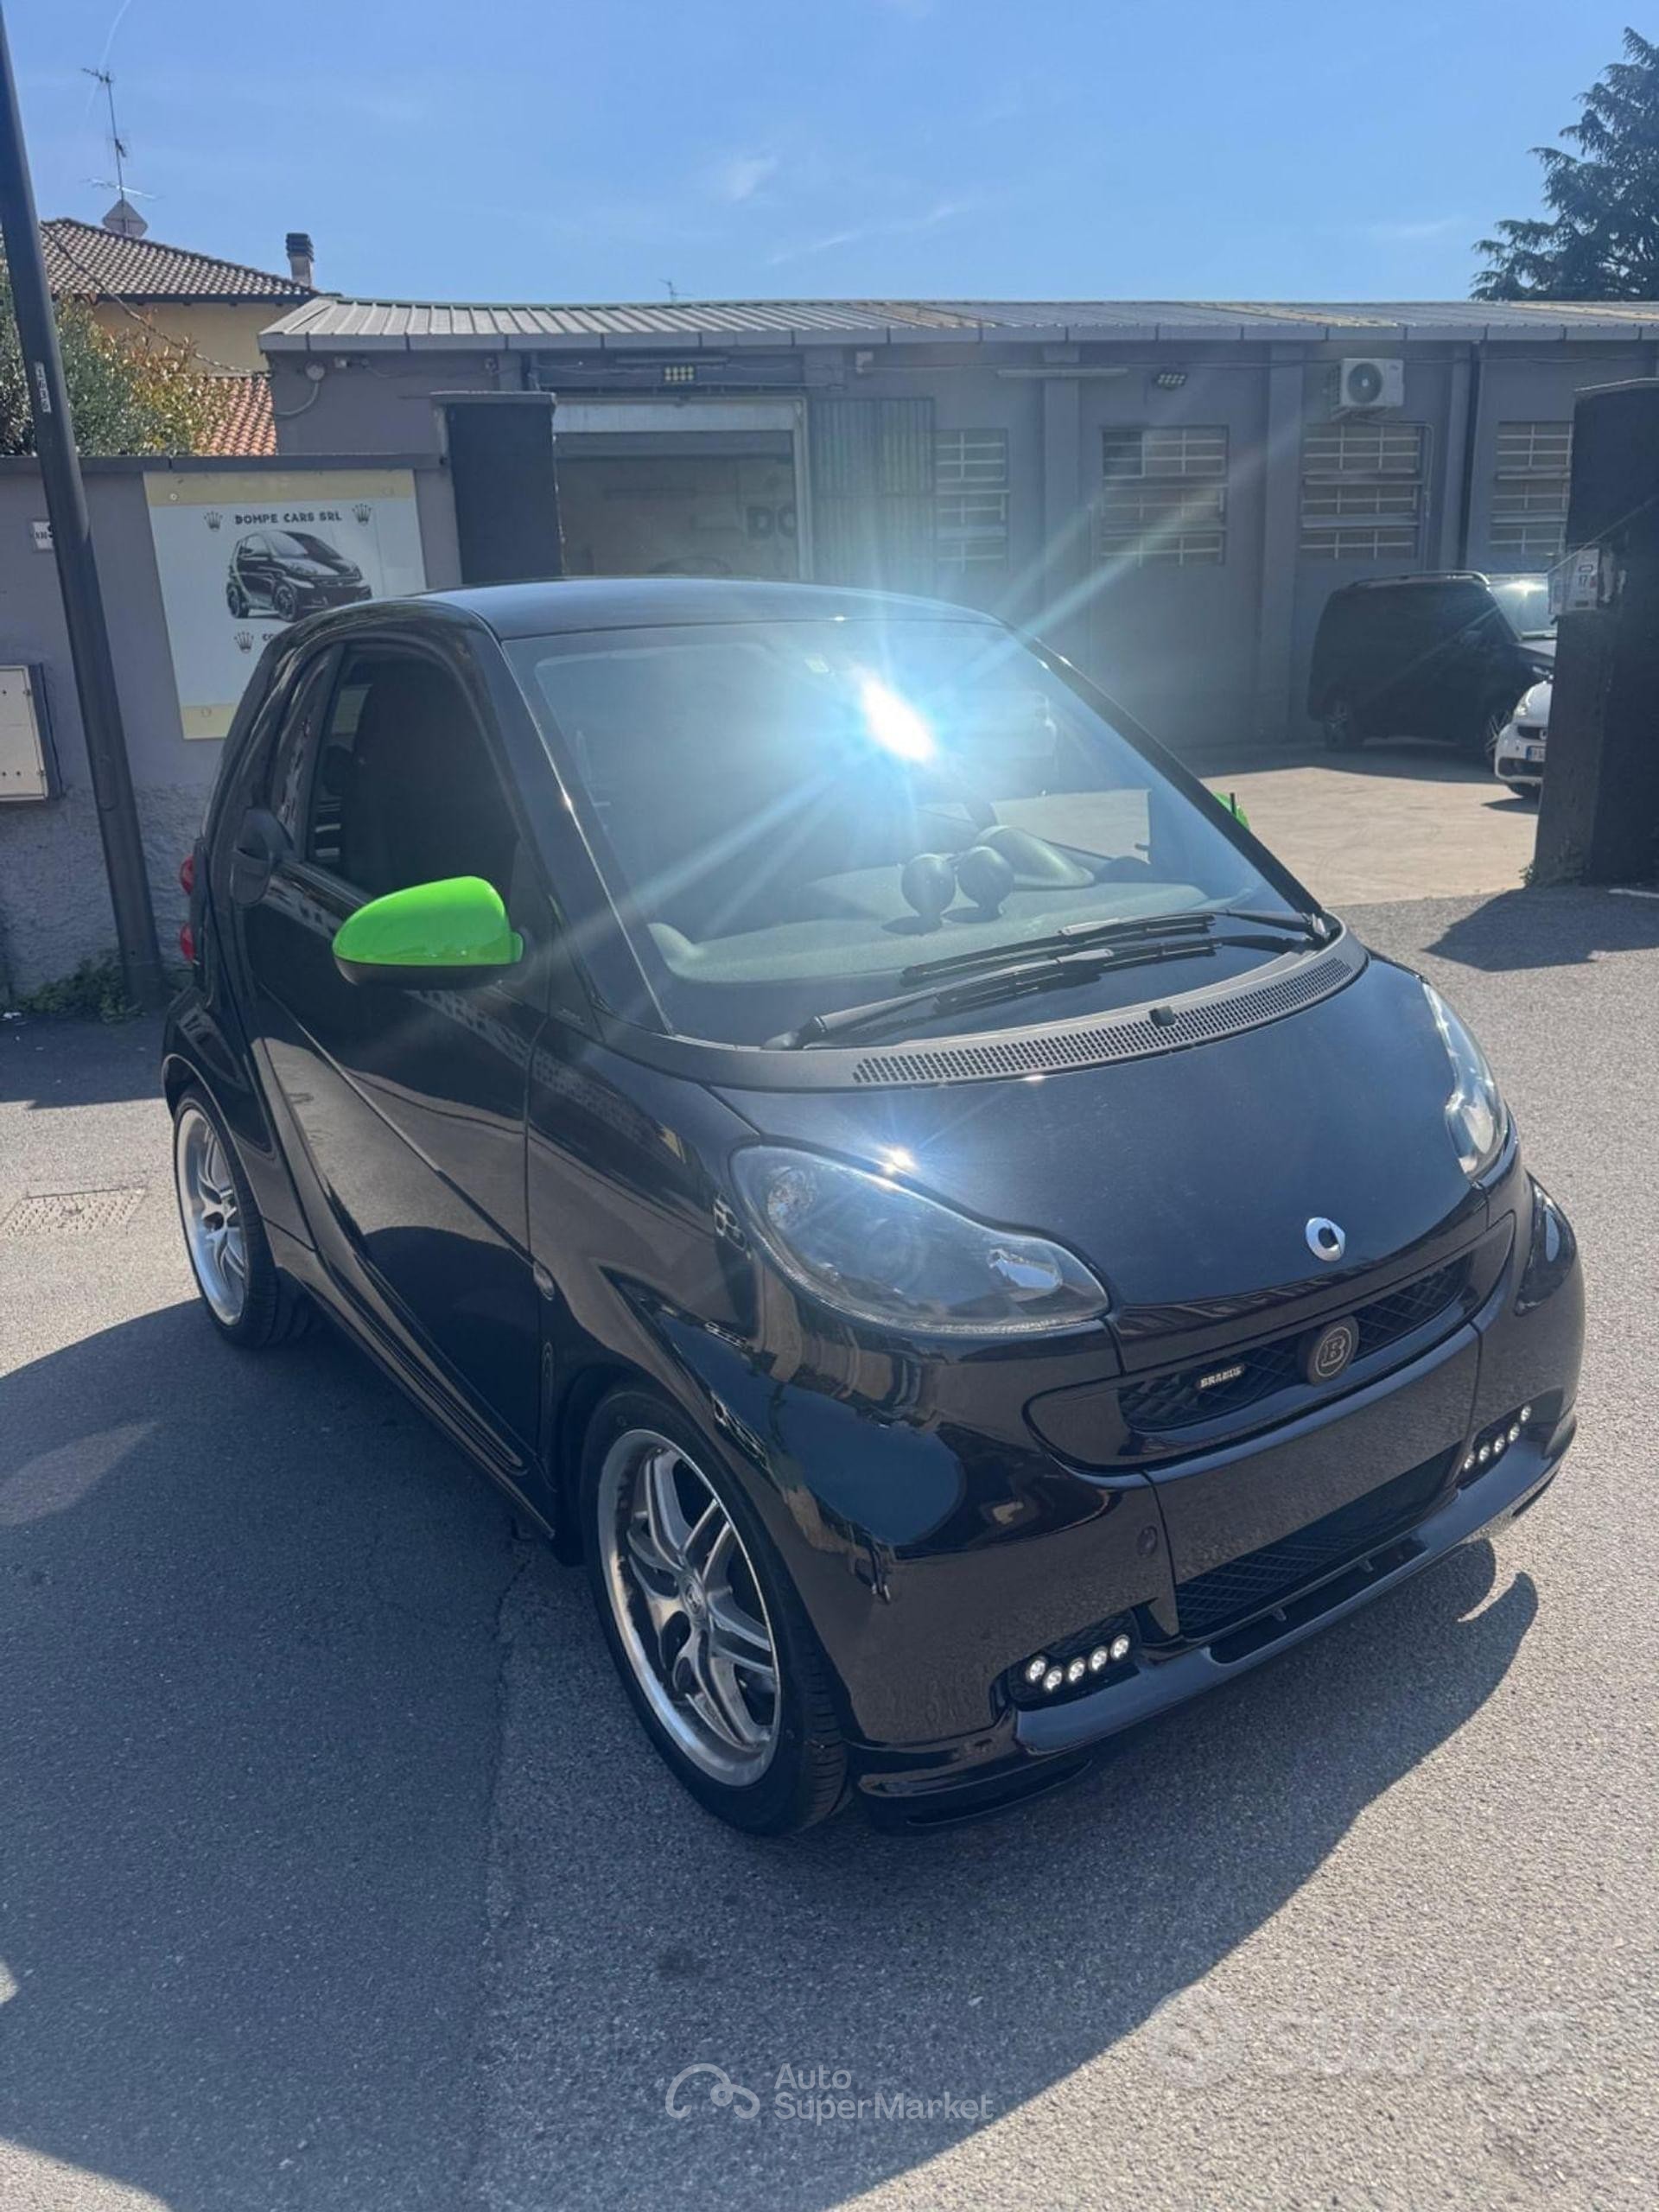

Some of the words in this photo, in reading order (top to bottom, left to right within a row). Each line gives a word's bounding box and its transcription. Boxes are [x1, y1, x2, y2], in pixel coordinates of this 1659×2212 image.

[234, 512, 279, 524] DOMPE
[283, 512, 315, 523] CARS
[319, 511, 343, 522] SRL
